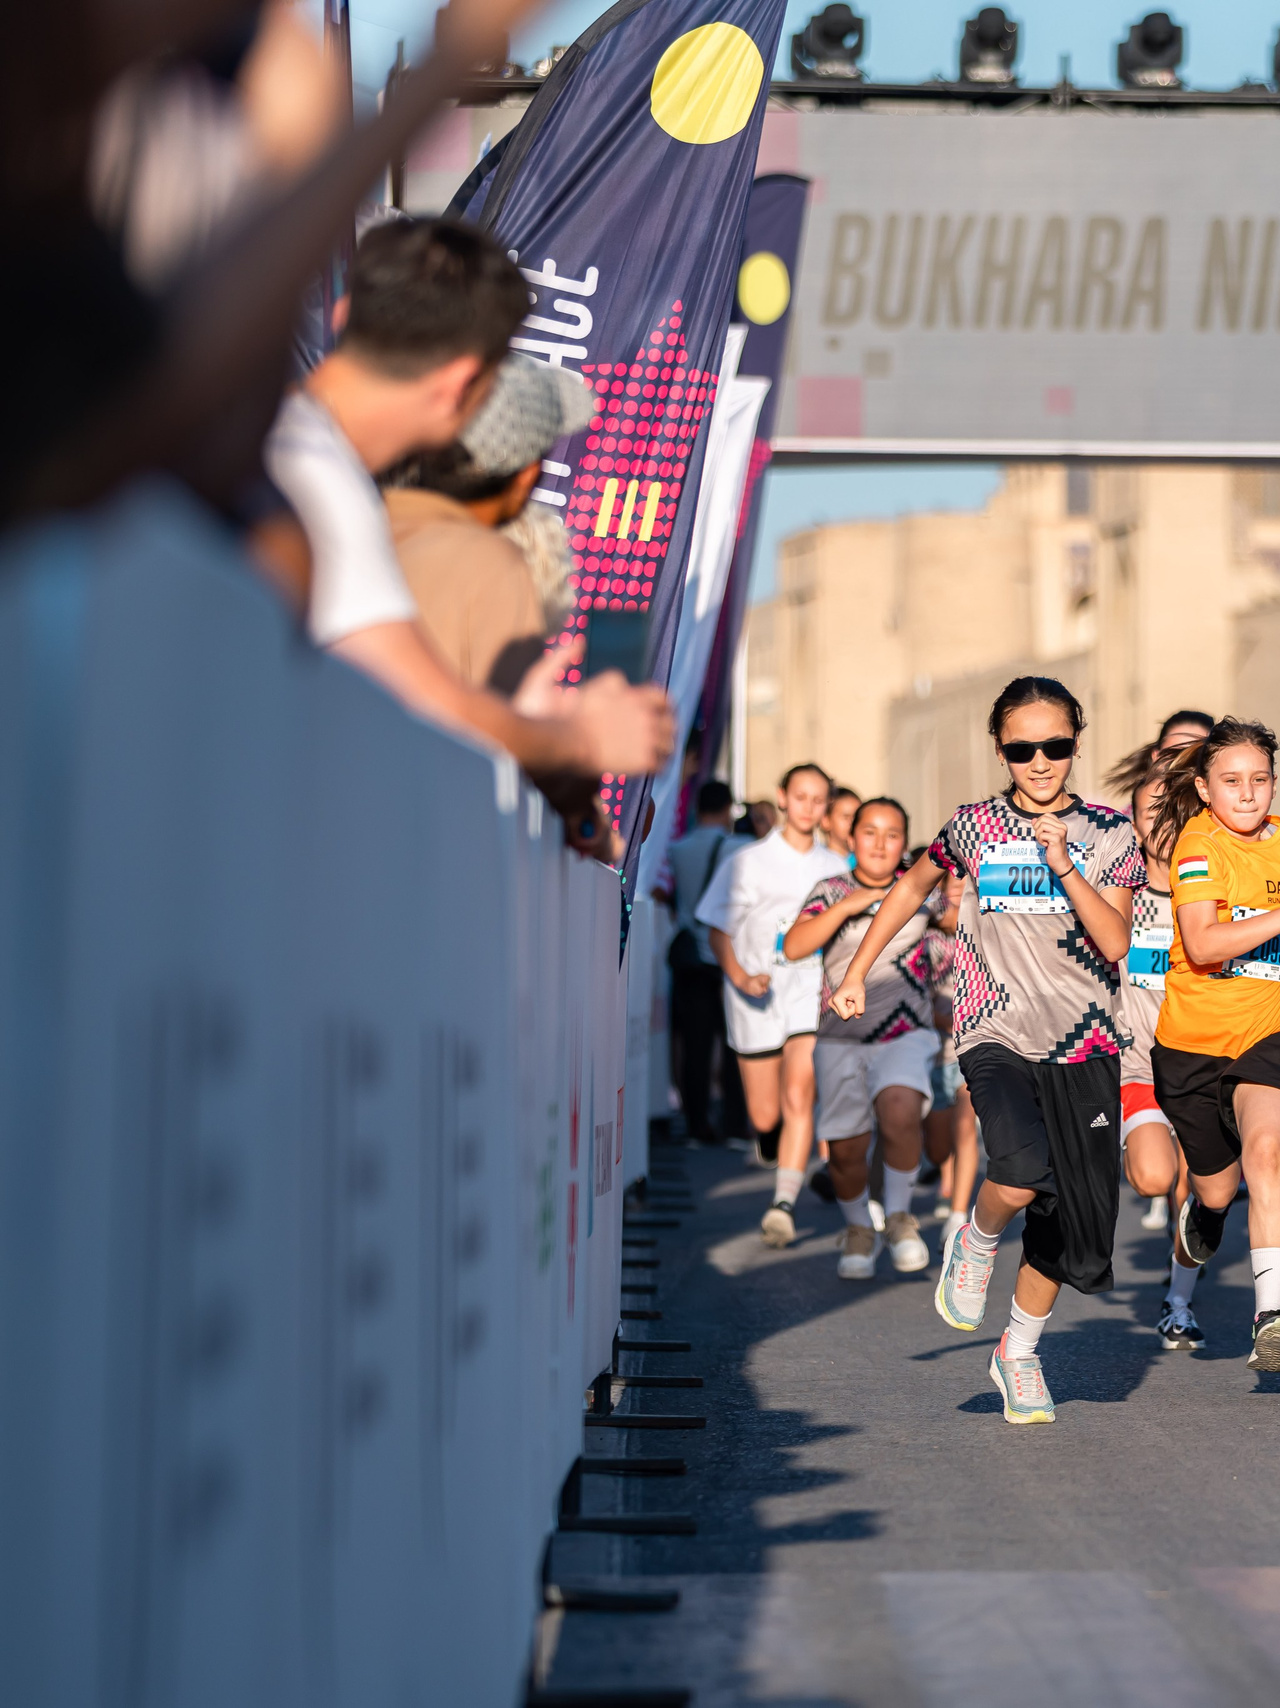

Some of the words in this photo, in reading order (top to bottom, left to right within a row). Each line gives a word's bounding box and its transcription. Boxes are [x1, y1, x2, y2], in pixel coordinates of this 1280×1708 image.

[506, 249, 600, 385] ACE
[820, 211, 1168, 333] BUKHARA
[1008, 866, 1055, 896] 2021
